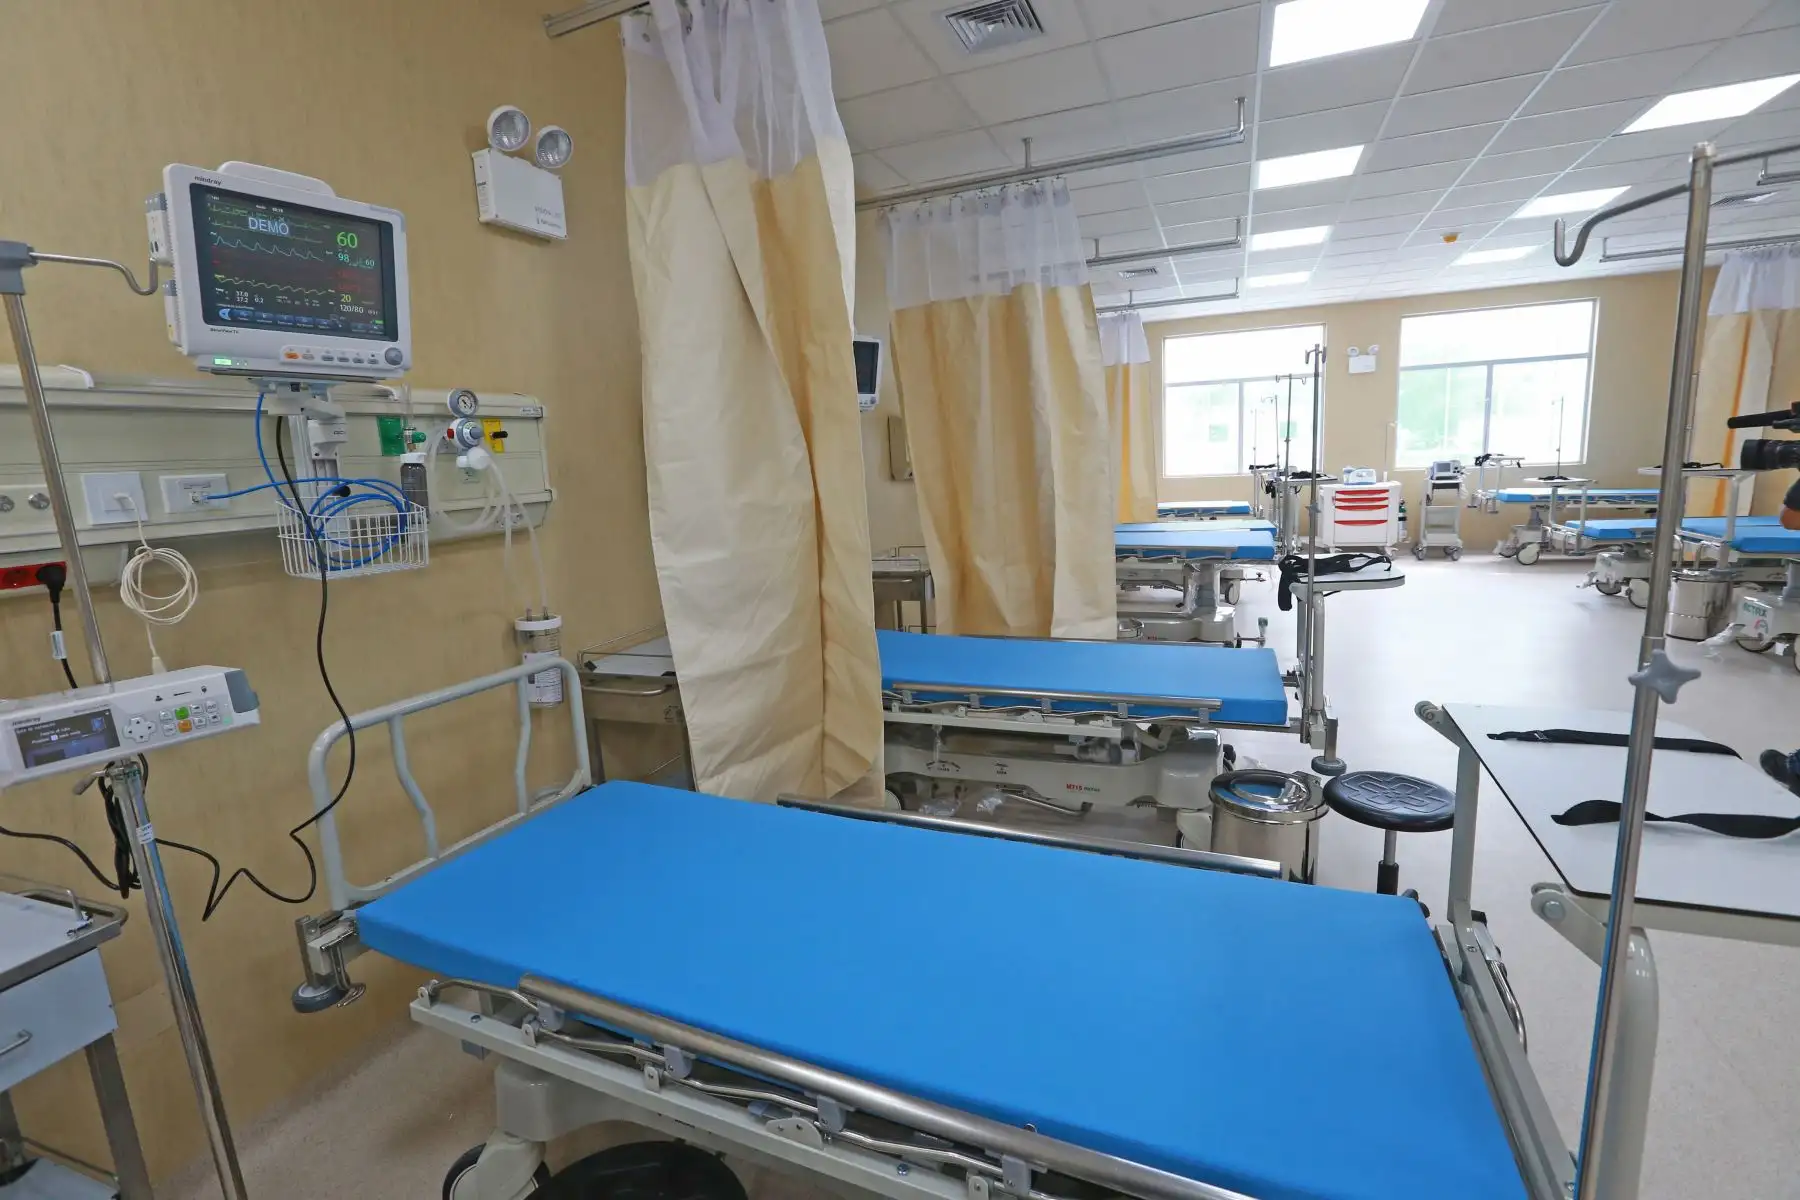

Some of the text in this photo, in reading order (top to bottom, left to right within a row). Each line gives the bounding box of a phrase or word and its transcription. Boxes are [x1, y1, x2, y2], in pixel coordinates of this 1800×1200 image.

[194, 175, 222, 186] mindray
[248, 217, 290, 235] DEMO
[336, 231, 358, 249] 60
[337, 252, 350, 263] 98
[365, 258, 376, 267] 60
[340, 293, 352, 303] 20
[339, 303, 364, 314] 120/80
